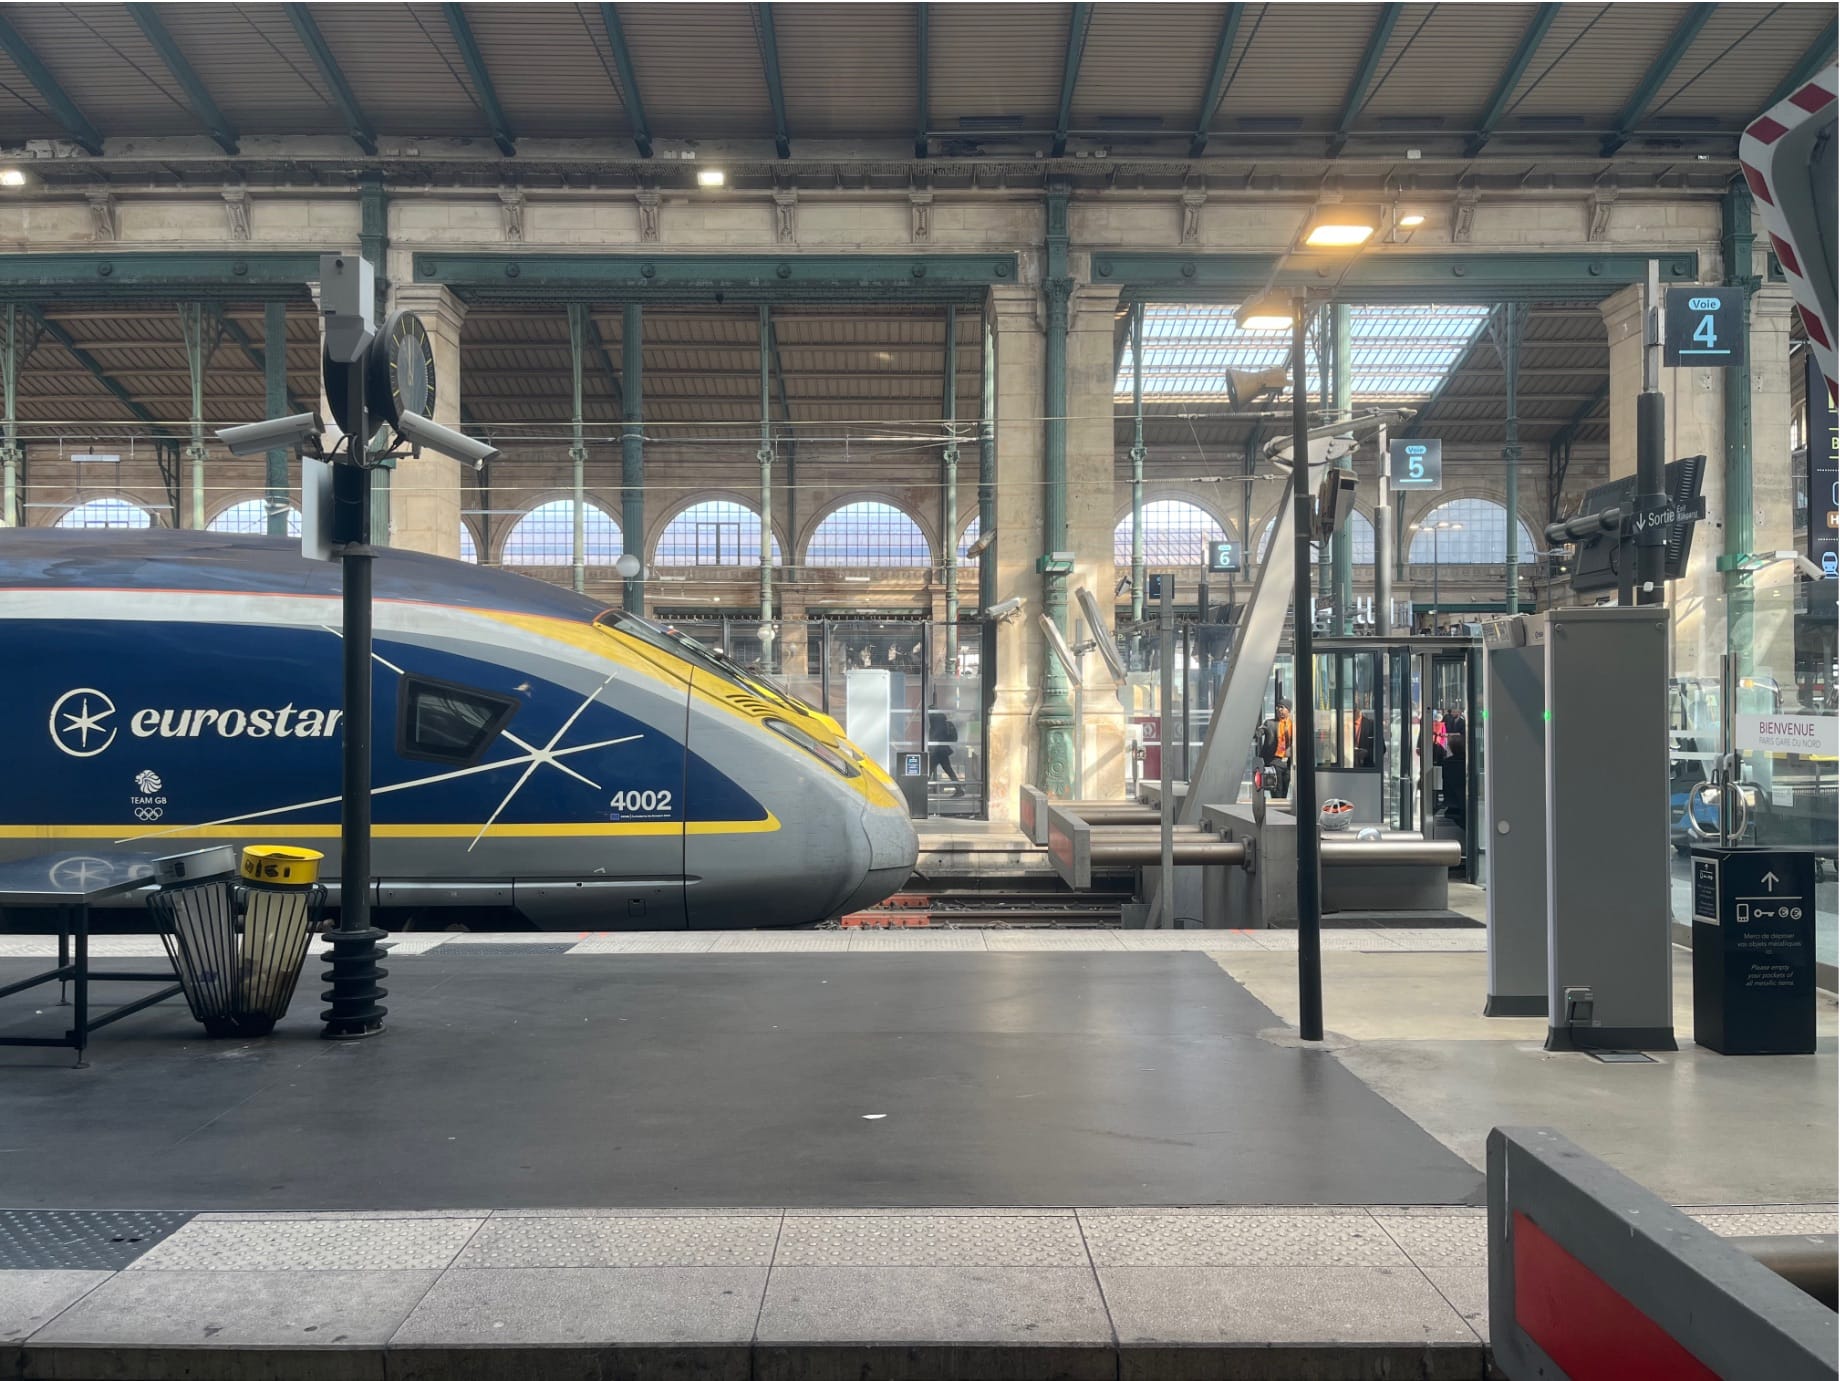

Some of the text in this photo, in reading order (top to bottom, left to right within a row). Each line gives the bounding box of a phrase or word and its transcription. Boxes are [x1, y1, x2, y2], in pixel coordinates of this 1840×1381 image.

[1692, 299, 1717, 309] Voie
[1693, 314, 1717, 348] 4
[1409, 456, 1424, 479] 5
[1648, 508, 1675, 527] Sortie
[1219, 551, 1231, 566] 6
[130, 701, 344, 738] eurostar
[1759, 721, 1815, 737] BIENVENUE
[1758, 736, 1775, 746] PARIS
[1792, 738, 1801, 747] DU
[1802, 739, 1822, 749] NORD
[130, 796, 168, 805] TEAM GB
[610, 790, 672, 811] 4002
